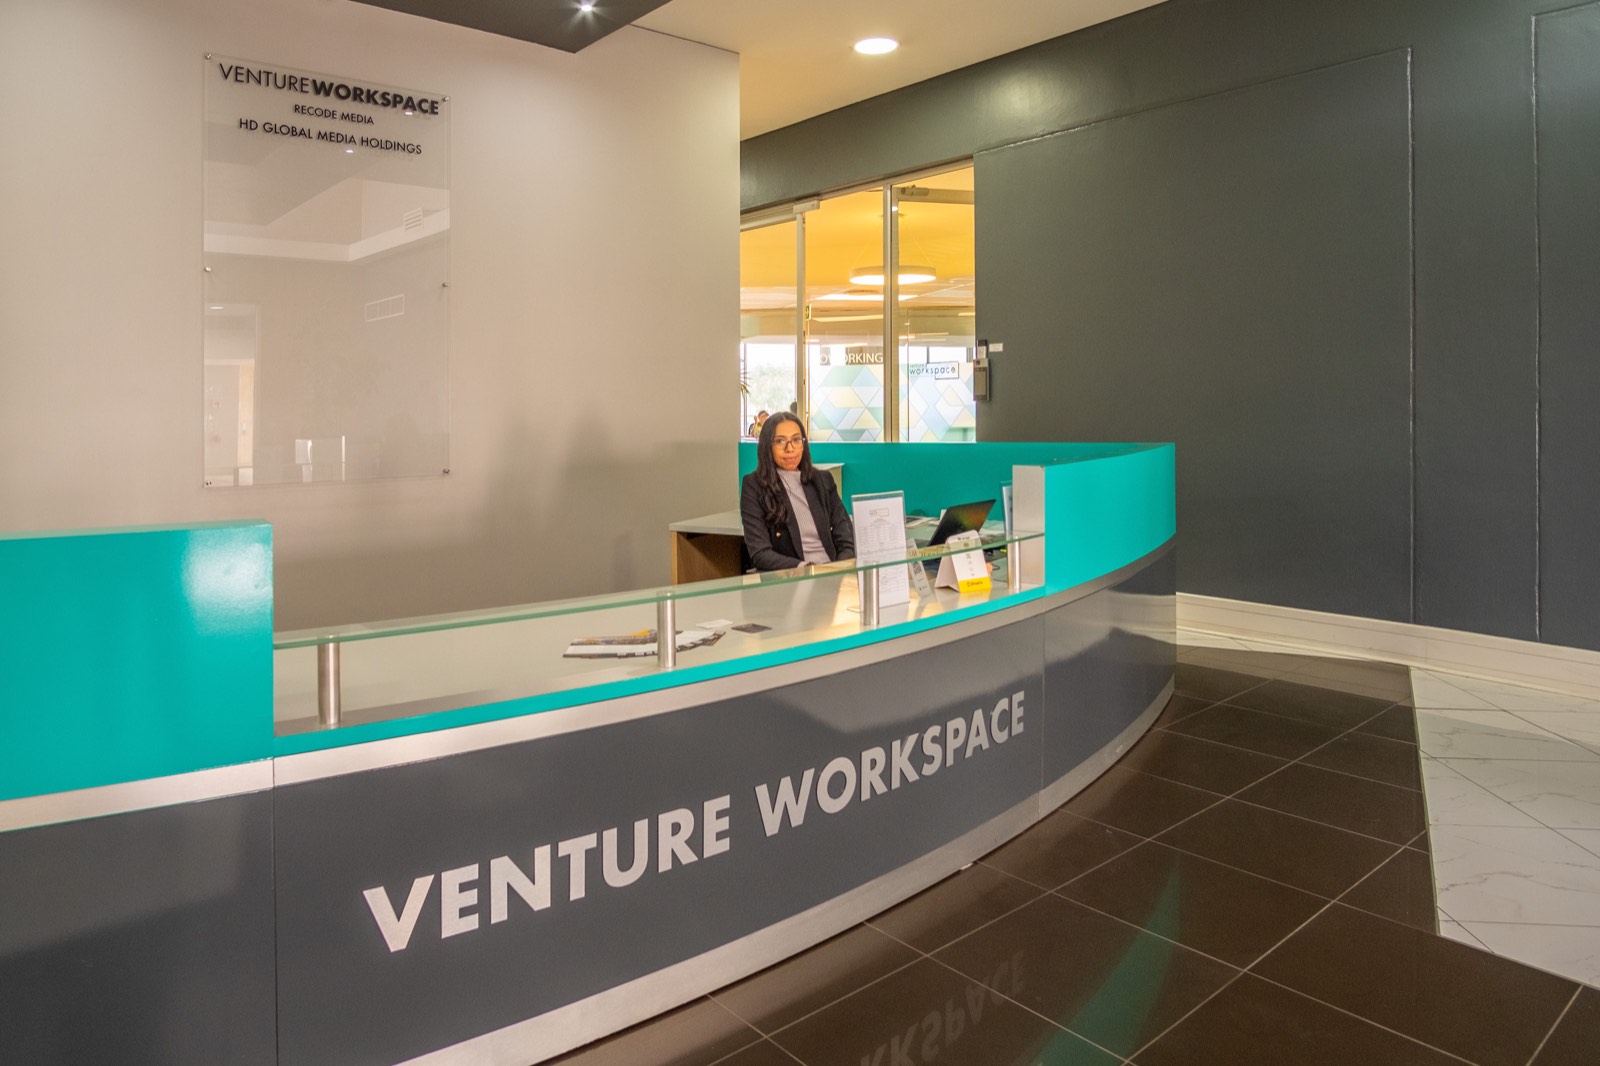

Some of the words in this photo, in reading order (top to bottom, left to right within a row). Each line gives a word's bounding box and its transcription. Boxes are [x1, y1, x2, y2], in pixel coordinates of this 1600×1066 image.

[219, 62, 439, 115] VENTUREWORKSPACE
[239, 118, 258, 131] HD
[262, 122, 313, 139] GLOBAL
[317, 130, 357, 145] MEDIA
[360, 136, 422, 155] HOLDINGS
[294, 104, 338, 119] RECODE
[341, 111, 375, 125] MEDIA
[362, 795, 731, 953] VENTURE
[754, 691, 1026, 837] WORKSPACE
